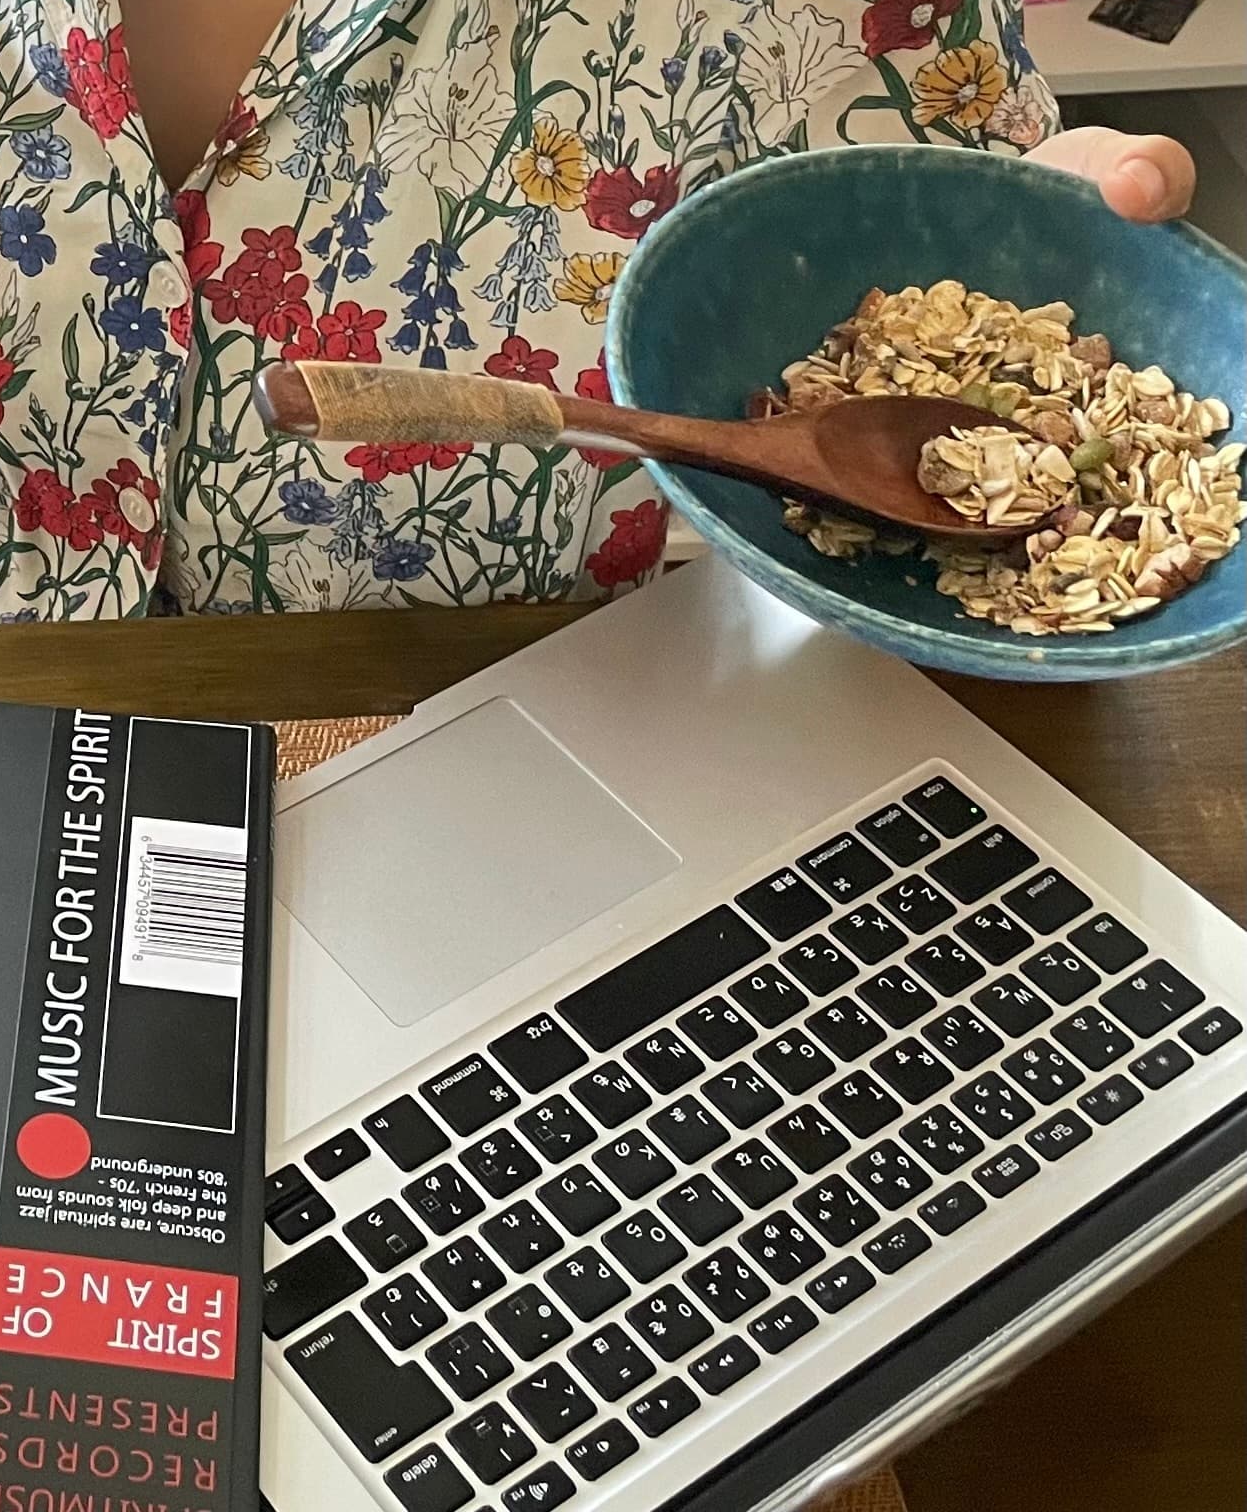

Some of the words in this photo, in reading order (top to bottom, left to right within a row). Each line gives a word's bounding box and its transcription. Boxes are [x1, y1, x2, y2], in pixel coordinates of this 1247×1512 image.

[66, 708, 112, 805] SPIRIT
[872, 809, 902, 828] option
[58, 811, 102, 880] THE
[808, 838, 853, 869] command
[920, 883, 938, 901] Z
[49, 886, 96, 964] FOR
[871, 916, 889, 931] X
[996, 917, 1012, 931] A
[799, 946, 816, 959] そ
[823, 948, 839, 962] C
[926, 946, 942, 958] と
[951, 943, 966, 962] S
[1039, 953, 1058, 967] た
[1062, 958, 1080, 972] Q
[751, 976, 767, 990] ひ
[774, 980, 790, 995] V
[878, 977, 895, 988] し
[901, 975, 918, 993] D
[1159, 981, 1174, 993] 1
[992, 986, 1010, 1000] て
[1013, 983, 1034, 1005] W
[697, 1007, 715, 1022] こ
[723, 1005, 739, 1024] B
[827, 1008, 845, 1022] は
[855, 1006, 869, 1025] F
[526, 1018, 553, 1039] かな
[968, 1015, 985, 1033] E
[1097, 1016, 1114, 1034] 2
[34, 971, 88, 1107] MUSIC
[646, 1039, 662, 1053] み
[668, 1042, 687, 1058] N
[799, 1044, 815, 1058] G
[895, 1049, 911, 1064] す
[917, 1047, 935, 1066] R
[1049, 1048, 1064, 1066] 3
[431, 1061, 482, 1096] command
[592, 1074, 610, 1087] も
[612, 1075, 633, 1093] M
[722, 1076, 737, 1089] く
[745, 1072, 765, 1093] H
[843, 1081, 859, 1097] か
[868, 1086, 884, 1100] T
[999, 1089, 1012, 1101] 4
[536, 1107, 554, 1127] ね
[669, 1107, 687, 1122] ま
[696, 1110, 709, 1125] J
[788, 1115, 806, 1130] ん
[374, 1117, 389, 1129] fn
[815, 1120, 831, 1136] Y
[949, 1120, 964, 1135] 5
[560, 1133, 571, 1143] <
[481, 1141, 498, 1156] る
[614, 1142, 631, 1157] の
[638, 1144, 657, 1161] K
[90, 1156, 193, 1179] underground
[734, 1152, 753, 1167] な
[759, 1149, 778, 1171] U
[896, 1155, 910, 1169] 6
[506, 1165, 518, 1175] >
[145, 1181, 197, 1201] French
[425, 1176, 441, 1191] め
[561, 1177, 578, 1194] り
[585, 1180, 602, 1193] L
[16, 1185, 53, 1203] from
[58, 1190, 114, 1207] sounds
[202, 1190, 227, 1205] the
[680, 1186, 699, 1202] に
[846, 1190, 859, 1206] 7
[19, 1204, 51, 1223] jazz
[118, 1197, 148, 1215] folk
[152, 1202, 192, 1221] deep
[449, 1202, 462, 1215] ?
[54, 1206, 116, 1230] spiritual
[196, 1207, 227, 1222] and
[502, 1213, 520, 1228] れ
[120, 1217, 152, 1232] rare
[156, 1219, 226, 1244] Obscure,
[626, 1222, 643, 1238] ら
[649, 1226, 666, 1242] O
[790, 1227, 804, 1242] 8
[446, 1248, 462, 1265] け
[566, 1260, 585, 1277] せ
[598, 1262, 611, 1279] P
[707, 1260, 722, 1276] よ
[736, 1265, 750, 1279] 9
[6, 1263, 223, 1319] FRANCE
[537, 1304, 552, 1318] @
[2, 1305, 53, 1338] OF
[107, 1318, 222, 1360] SPIRIT
[300, 1332, 335, 1358] return
[374, 1427, 398, 1447] enter
[401, 1454, 438, 1482] delete
